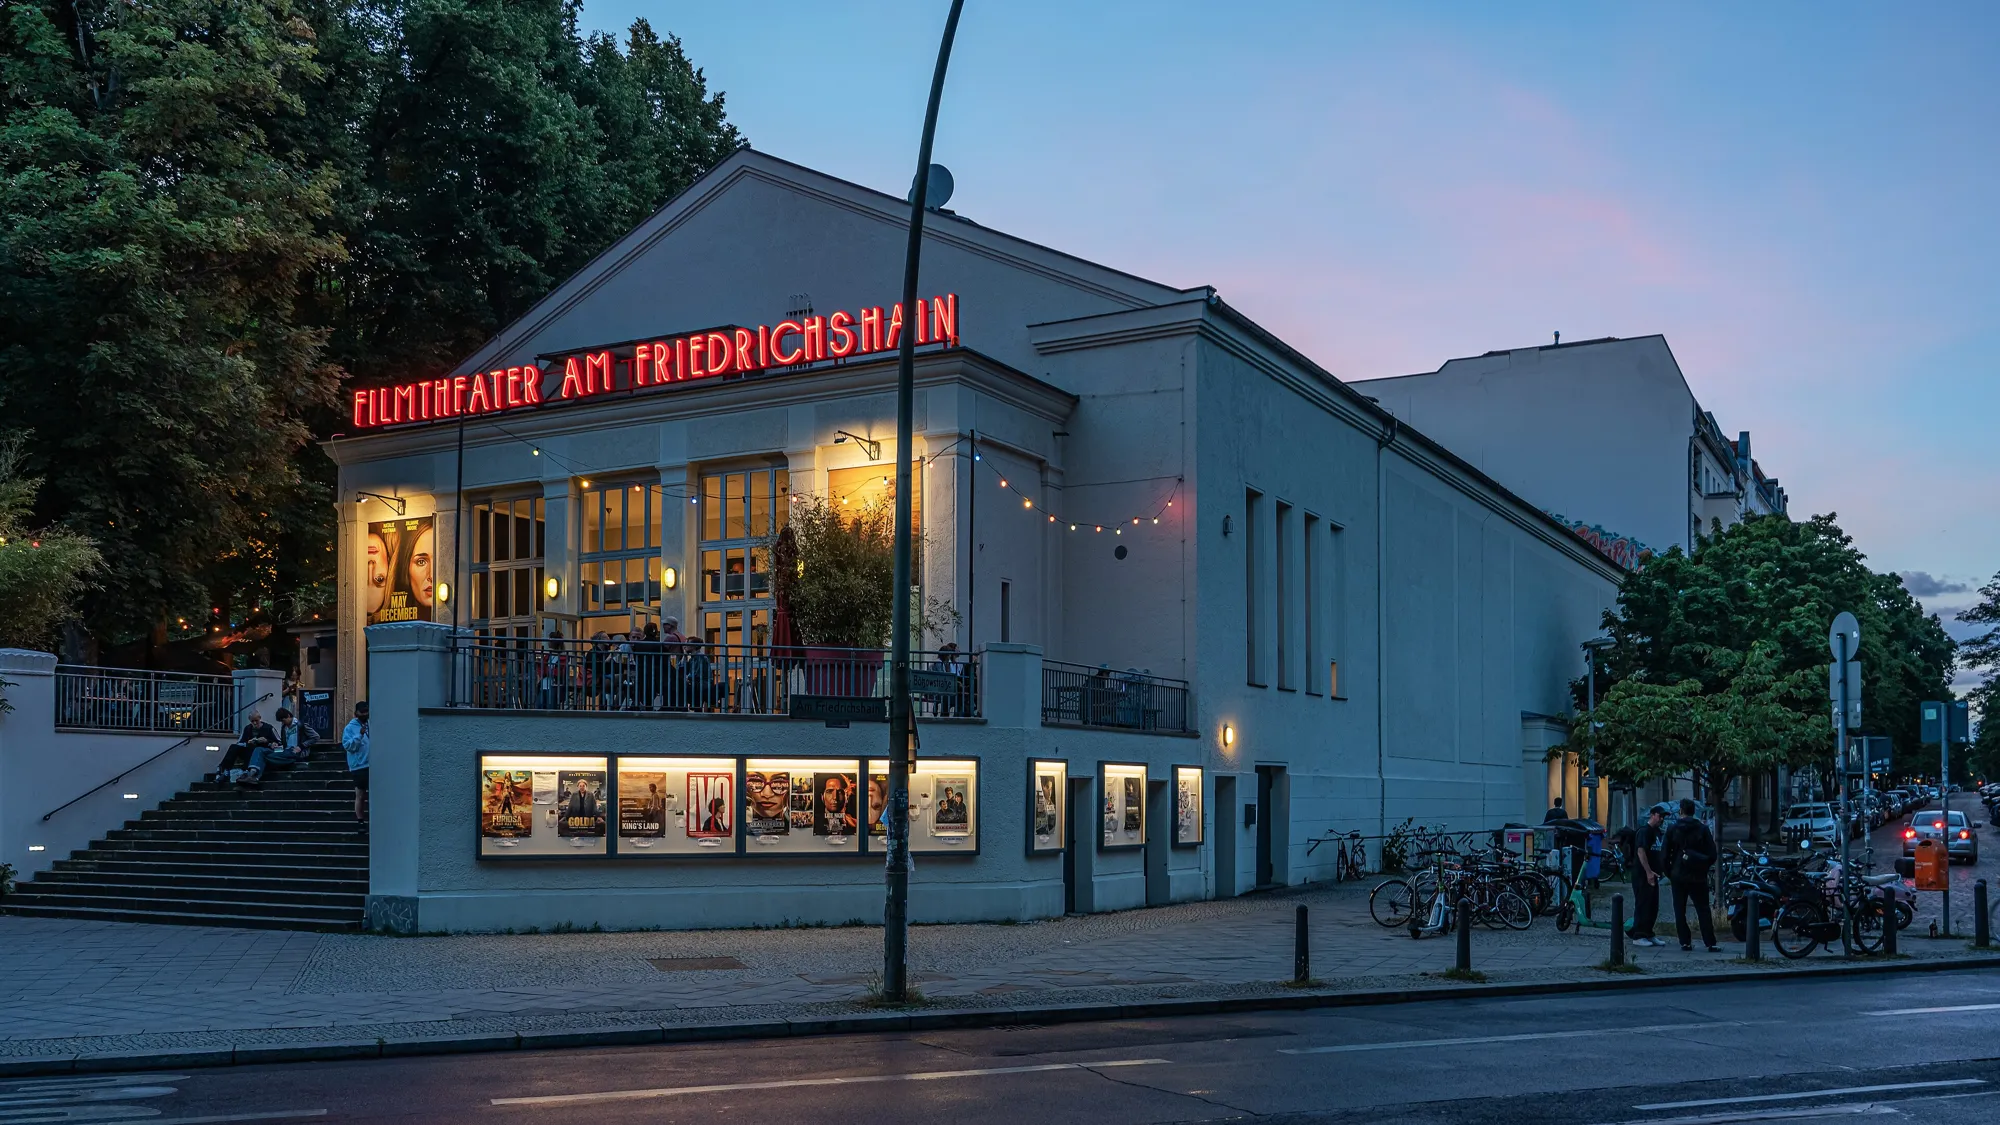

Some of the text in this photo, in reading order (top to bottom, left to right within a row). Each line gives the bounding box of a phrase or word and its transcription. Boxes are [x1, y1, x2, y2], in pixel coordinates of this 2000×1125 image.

[353, 293, 960, 428] FILMTHEATER AM FRIEDRICHSHAIN
[391, 595, 408, 608] MAY
[380, 607, 418, 622] DECEMBER
[796, 700, 880, 714] Am Friedrichshain
[689, 776, 730, 831] IVO
[492, 814, 522, 823] FURIOSA
[567, 816, 596, 827] GOLDA
